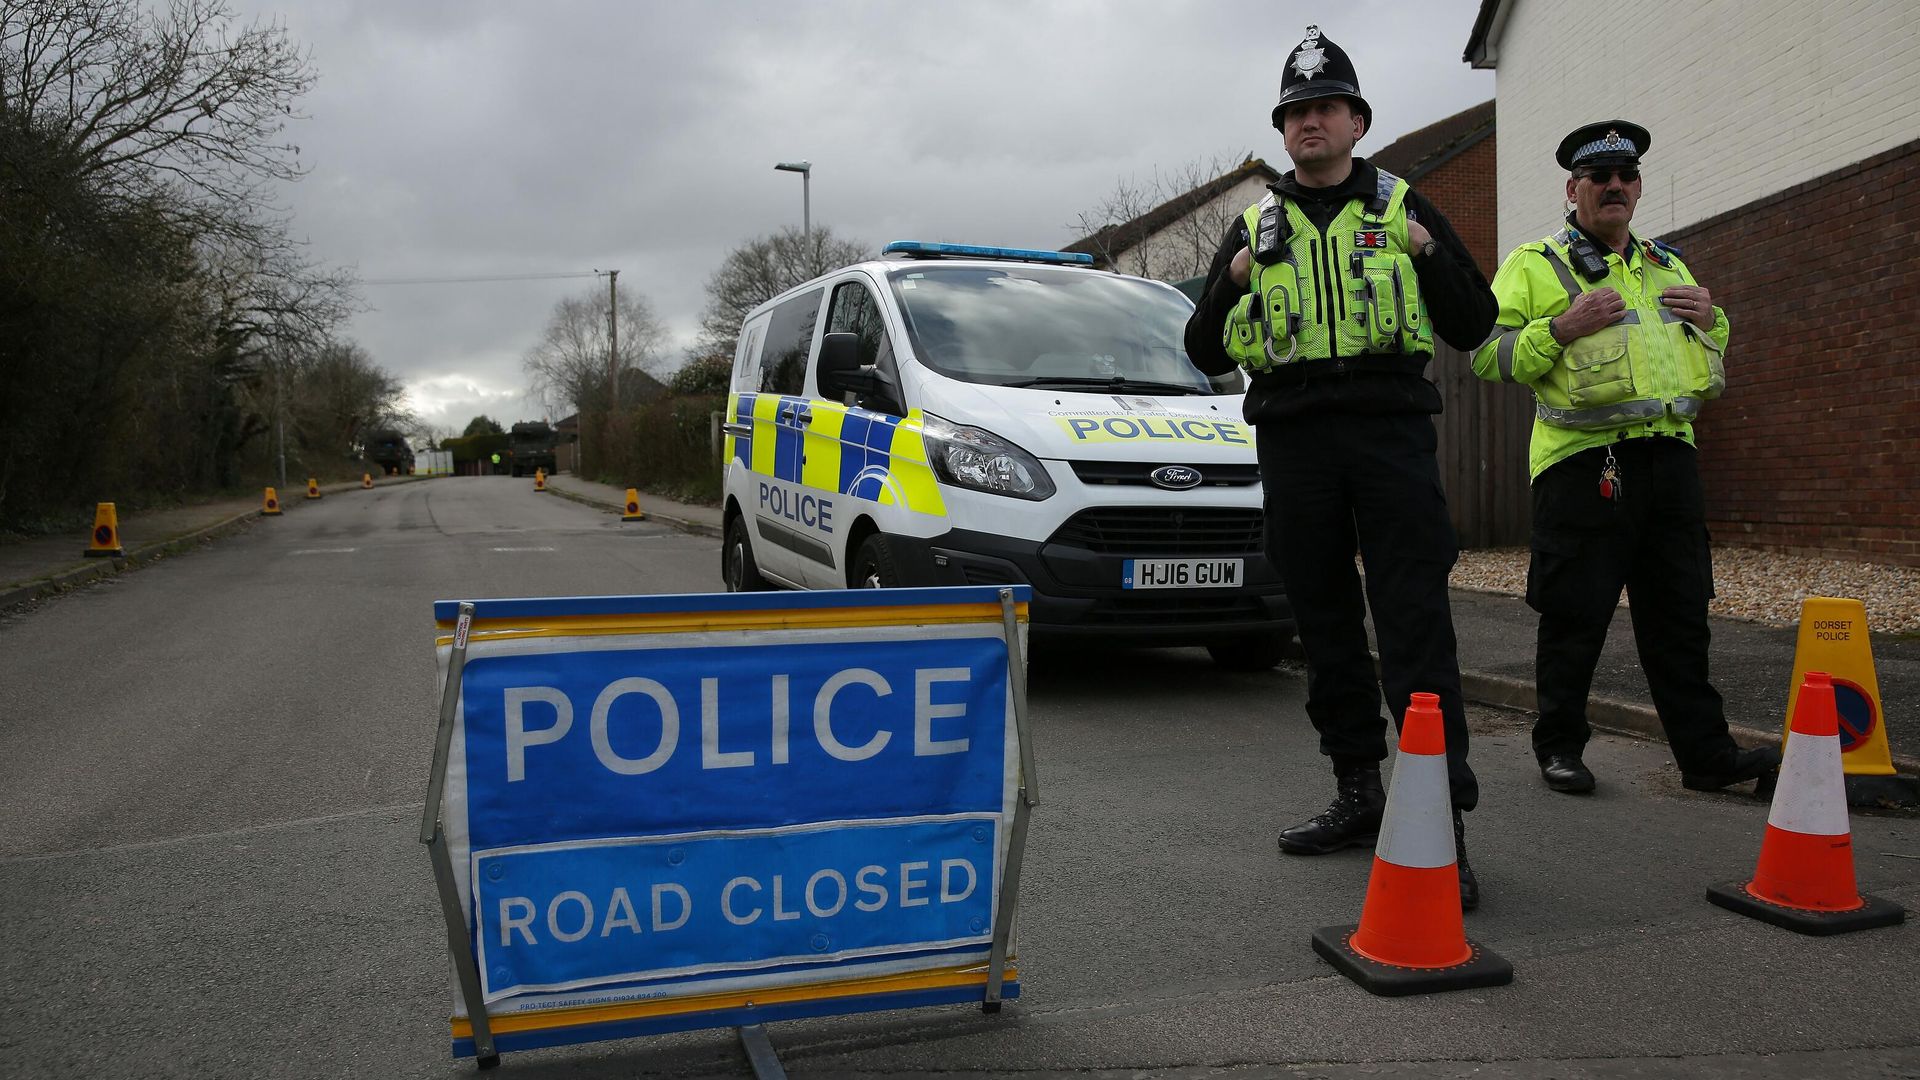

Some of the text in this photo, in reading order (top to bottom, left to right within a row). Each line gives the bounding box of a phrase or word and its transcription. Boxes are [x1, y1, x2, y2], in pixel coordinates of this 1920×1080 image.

[1168, 411, 1205, 420] Dorset
[1068, 418, 1248, 444] POLICE
[1164, 468, 1192, 481] Ford
[759, 482, 833, 534] POLICE
[1141, 563, 1189, 585] HJ16
[1195, 562, 1236, 584] GUW
[1813, 620, 1852, 630] DORSET
[1816, 631, 1850, 641] POLICE
[503, 667, 971, 782] POLICE
[500, 858, 977, 947] ROAD CLOSED
[559, 999, 585, 1007] SAFETY
[587, 996, 612, 1004] SIGNS
